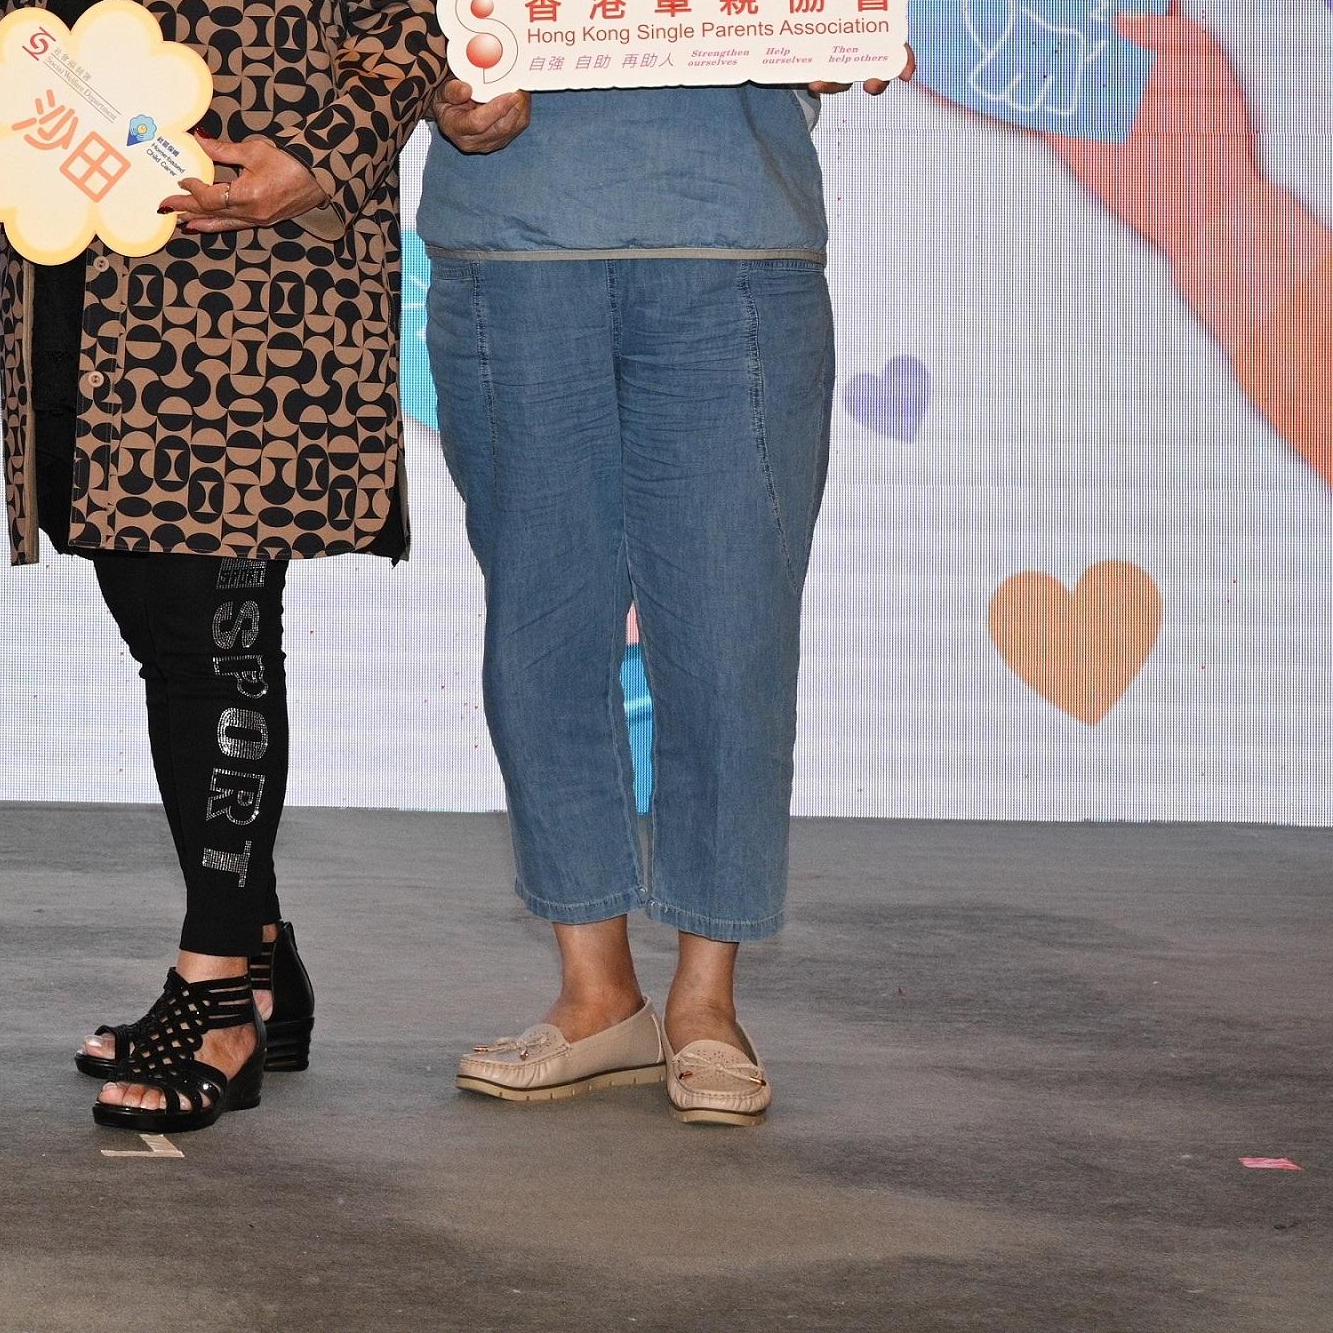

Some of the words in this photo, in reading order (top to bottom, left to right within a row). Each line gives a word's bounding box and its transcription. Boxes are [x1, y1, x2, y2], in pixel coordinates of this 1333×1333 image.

[527, 27, 575, 46] Hong
[582, 26, 630, 45] Kong
[637, 23, 695, 43] Single
[701, 21, 774, 38] Parents
[779, 18, 889, 36] Association
[690, 48, 750, 59] Strengthen
[765, 47, 791, 57] Help
[832, 45, 859, 54] Then
[528, 55, 565, 72] 自強
[574, 54, 611, 70] 自助
[621, 52, 674, 69] 再助人
[687, 58, 738, 67] ourselves
[762, 56, 813, 65] ourselves
[828, 54, 852, 64] help
[853, 54, 889, 63] others
[10, 88, 132, 204] 沙田
[201, 600, 268, 888] SPORT
